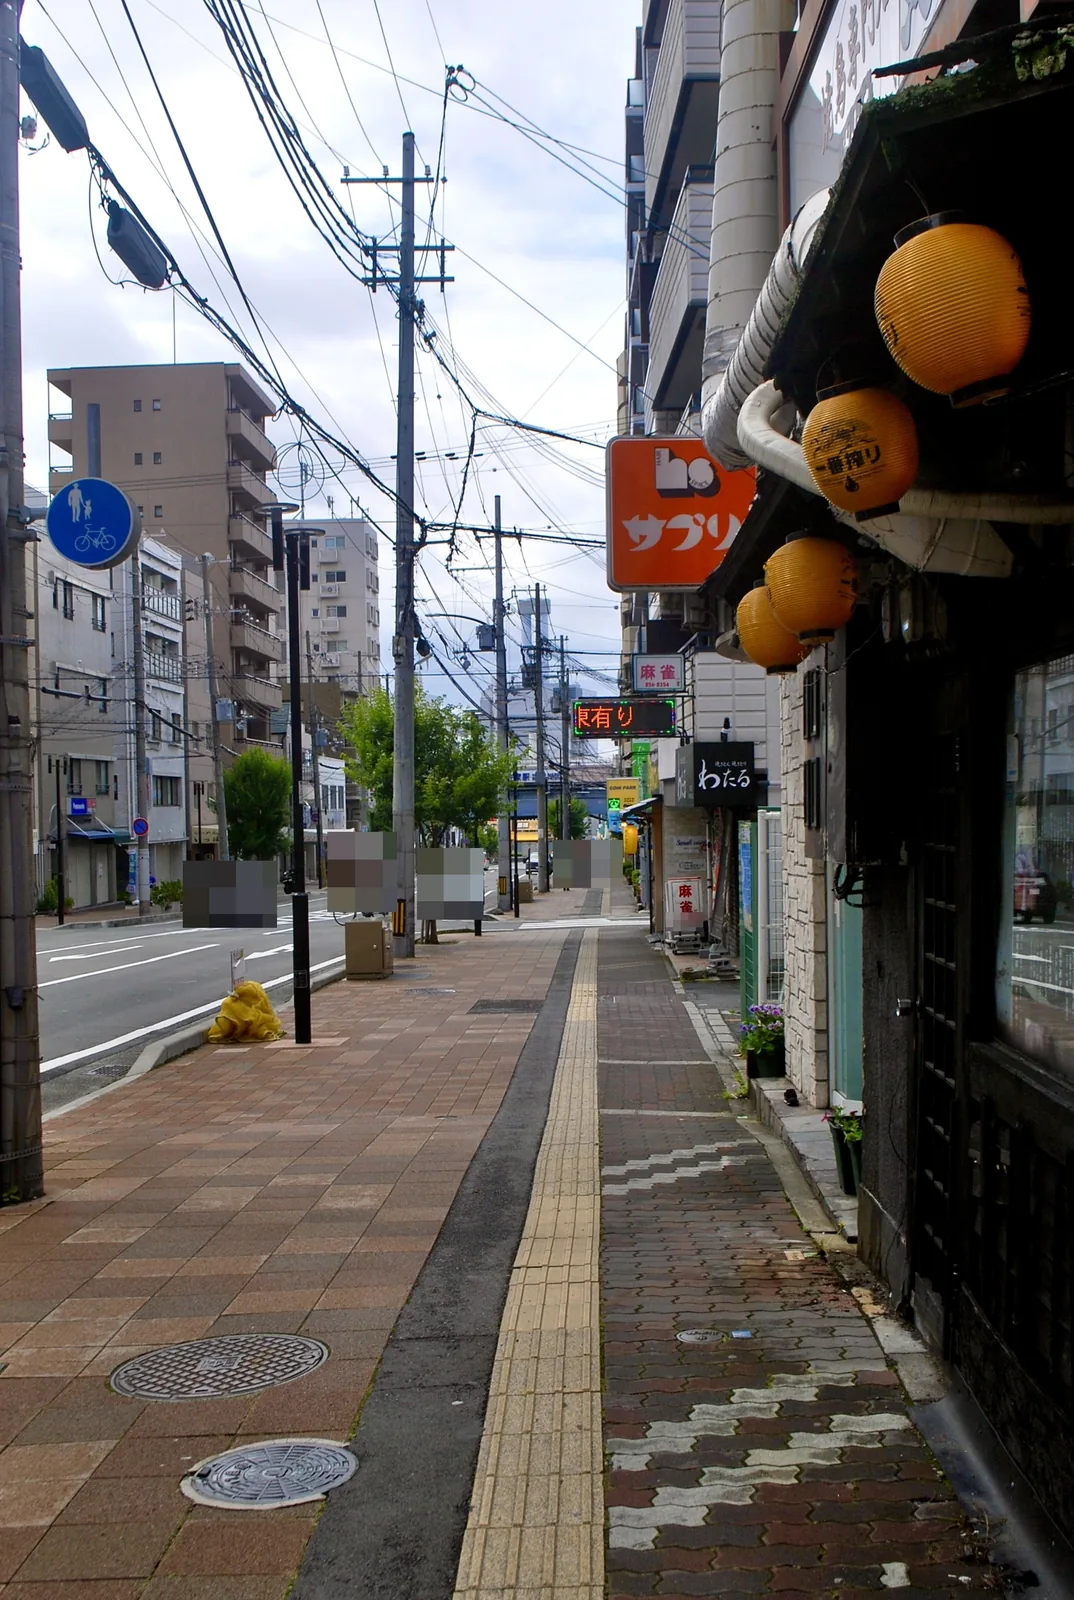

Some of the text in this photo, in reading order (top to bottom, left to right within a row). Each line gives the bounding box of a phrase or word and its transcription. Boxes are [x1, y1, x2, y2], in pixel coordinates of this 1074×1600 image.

[815, 444, 881, 475] 一番搾り
[640, 664, 676, 680] 麻雀
[698, 759, 751, 790] わたる
[678, 884, 694, 913] 麻雀
